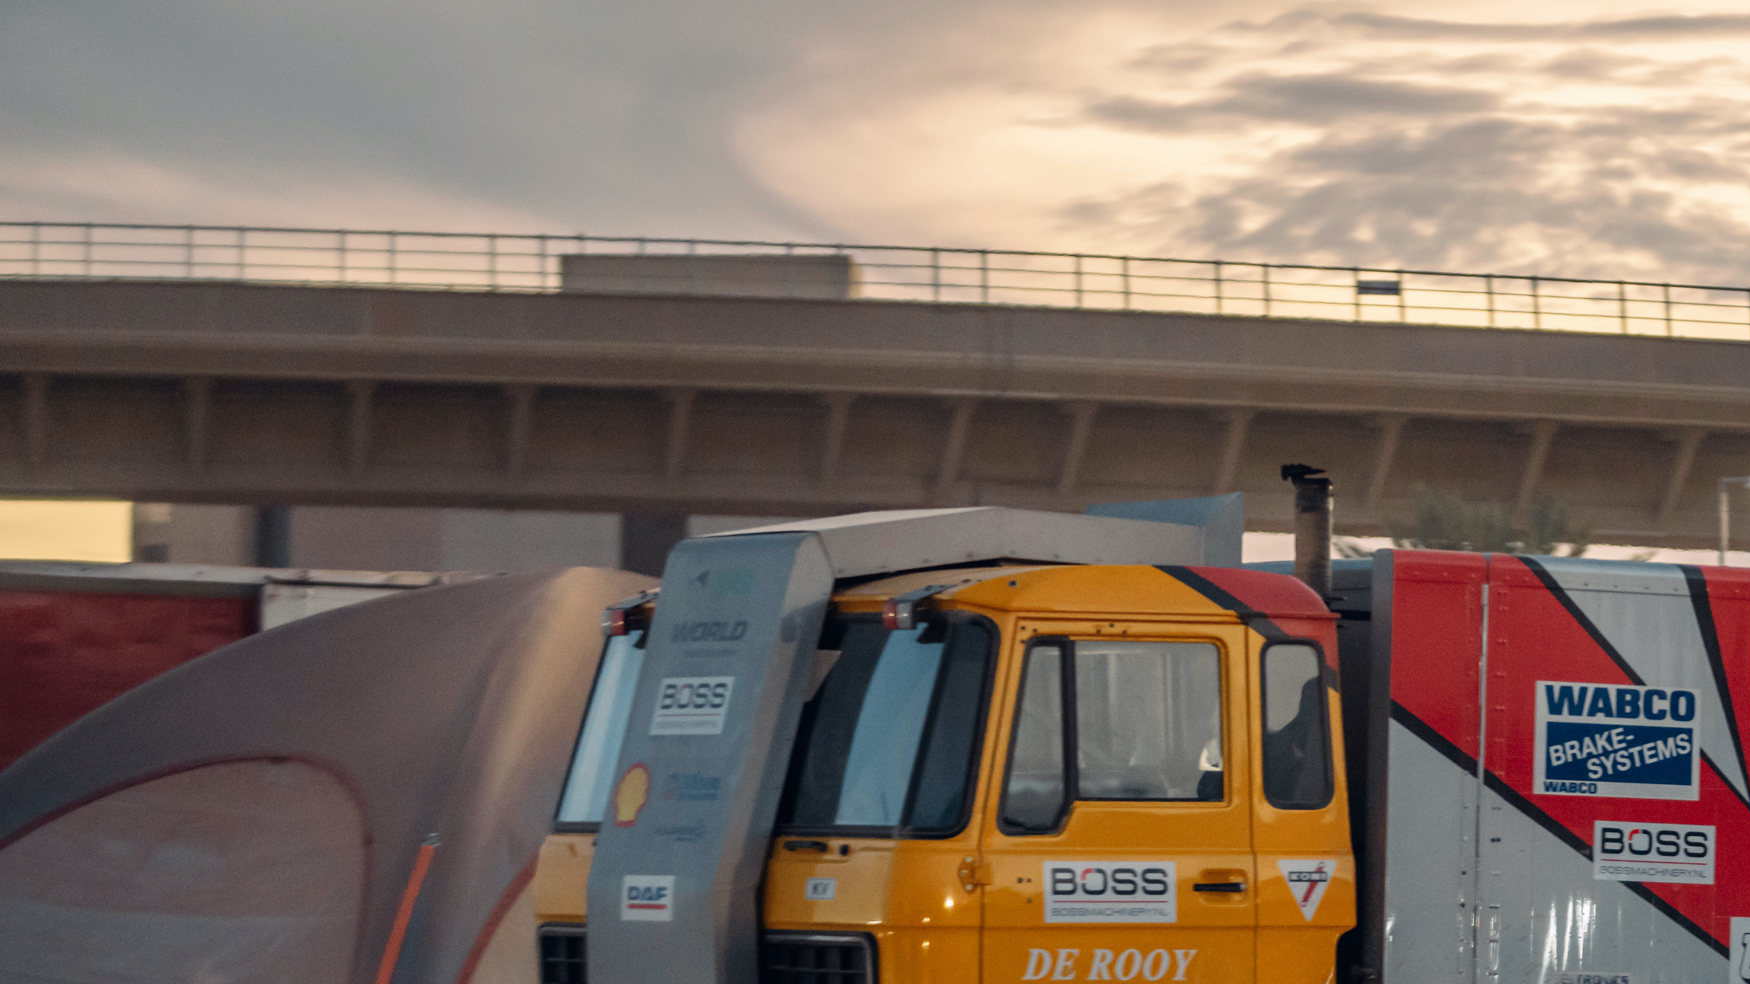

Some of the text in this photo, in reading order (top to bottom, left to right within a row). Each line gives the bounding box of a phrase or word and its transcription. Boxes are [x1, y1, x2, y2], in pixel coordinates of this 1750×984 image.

[670, 620, 748, 642] WORLD
[661, 682, 728, 710] BOSS
[1545, 684, 1696, 722] WABCO
[1549, 727, 1635, 767] BRAKE-
[1586, 733, 1691, 780] SYSTEMS
[1544, 781, 1598, 794] WABCO
[1602, 827, 1708, 858] BOSS
[627, 886, 667, 902] DAF
[1052, 867, 1168, 895] BOSS
[1021, 948, 1198, 982] DE ROOY
